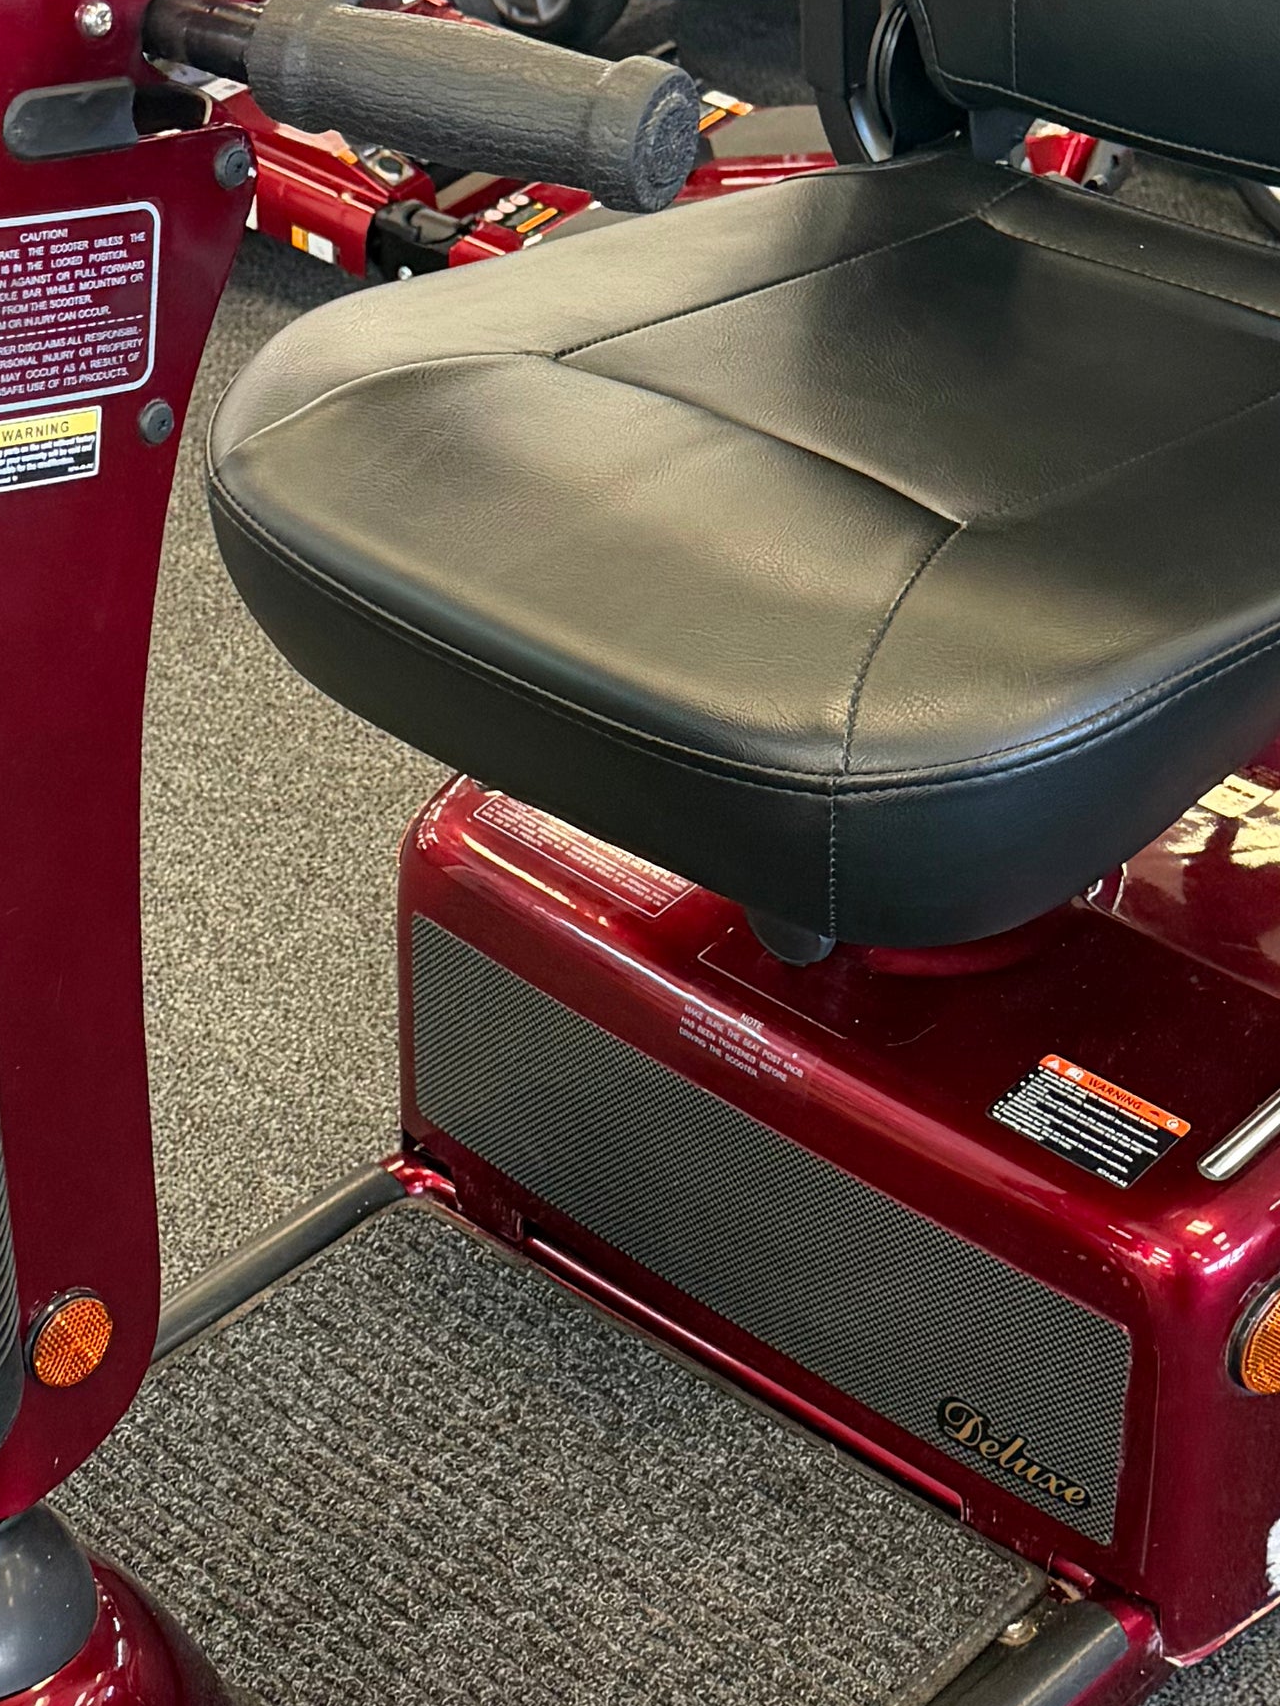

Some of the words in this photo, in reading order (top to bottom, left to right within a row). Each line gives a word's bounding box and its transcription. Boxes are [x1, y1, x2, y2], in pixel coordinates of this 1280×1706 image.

[20, 228, 68, 243] CAUTION!
[28, 246, 44, 257] THE
[130, 232, 146, 243] THE
[10, 274, 53, 288] AGAINST
[56, 271, 70, 282] OR
[101, 260, 145, 275] FORWARD
[26, 261, 43, 272] THE
[22, 287, 42, 299] BAR
[46, 283, 75, 296] WHILE
[79, 276, 126, 291] MOUNTING
[130, 273, 144, 283] OR
[1, 303, 28, 315] FROM
[30, 300, 47, 312] THE
[8, 318, 22, 329] OR
[23, 313, 56, 327] INJURY
[57, 310, 76, 322] CAN
[42, 350, 75, 363] INJURY
[78, 346, 92, 357] OR
[96, 337, 144, 354] PROPERTY
[66, 335, 82, 346] ALL
[0, 372, 21, 383] MAY
[25, 366, 59, 379] OCCUR
[63, 363, 76, 373] AS
[79, 362, 86, 371] A
[90, 355, 124, 369] RESULT
[127, 351, 140, 362] OF
[26, 381, 45, 392] USE
[47, 378, 61, 389] OF
[1, 421, 70, 442] WARNING
[740, 1012, 765, 1031] NOTE
[727, 1028, 741, 1042] THE
[1088, 1077, 1143, 1111] WARNING
[943, 1401, 1086, 1506] Deluxe
